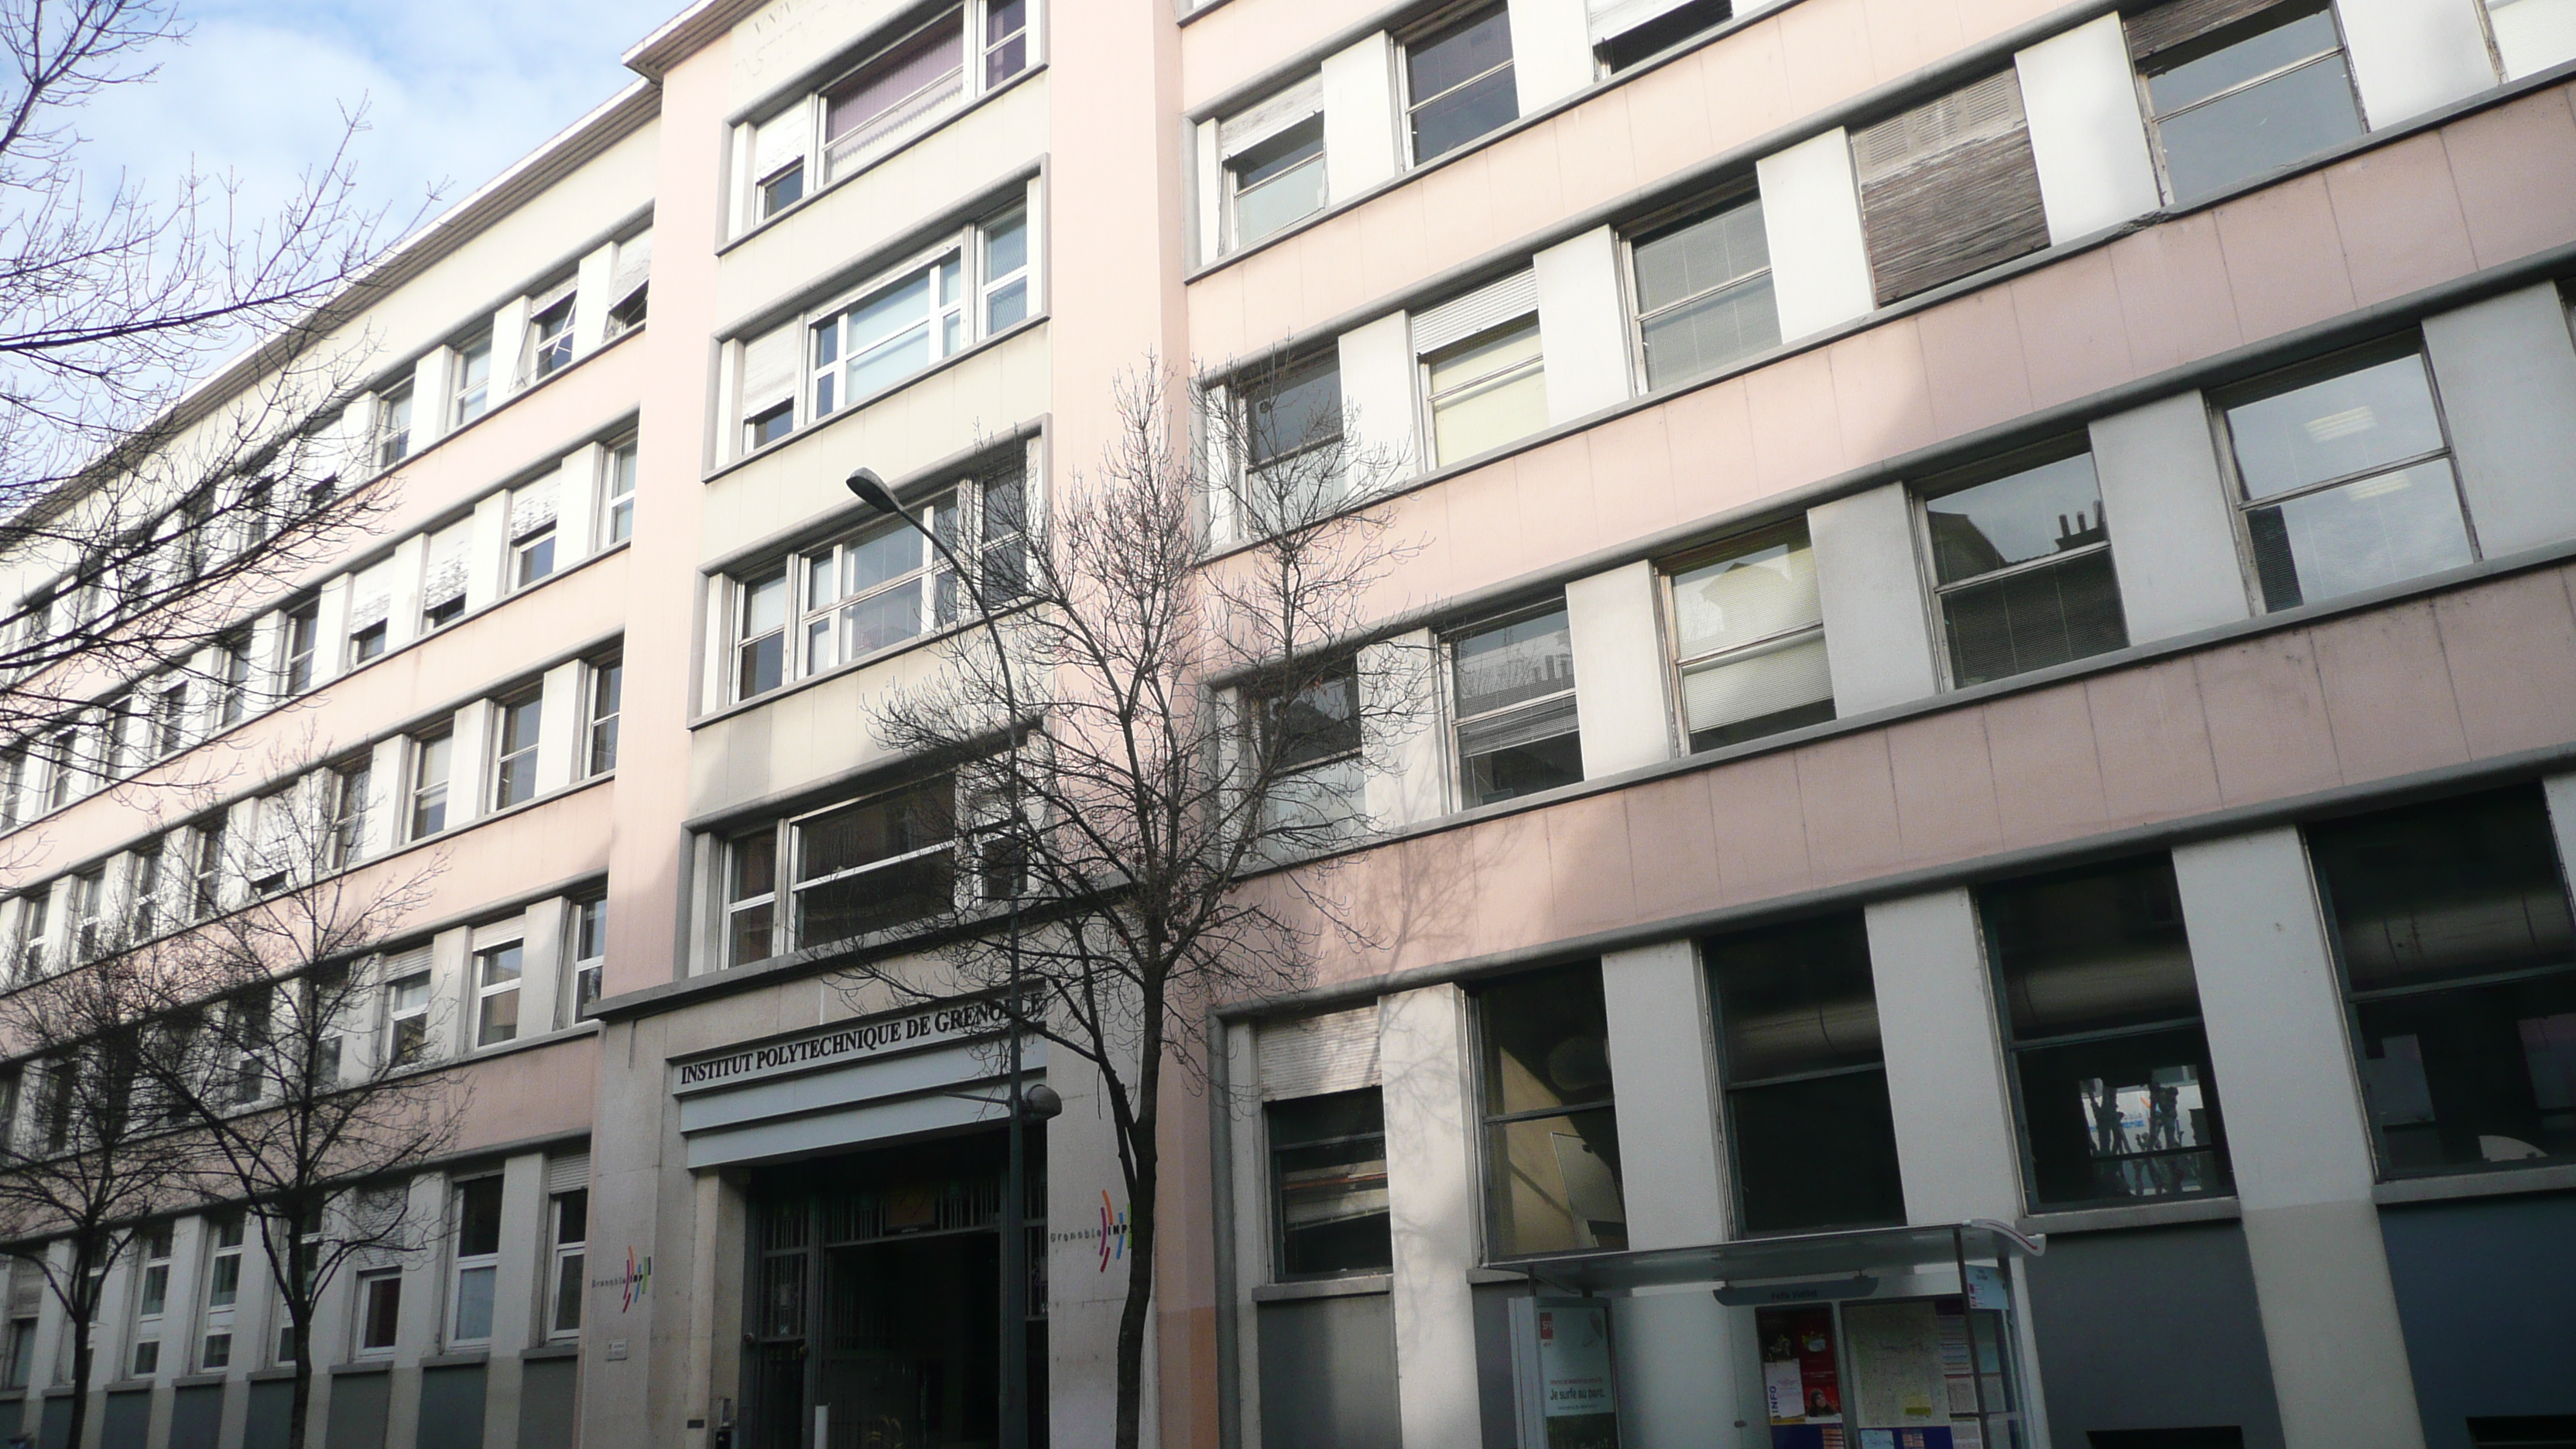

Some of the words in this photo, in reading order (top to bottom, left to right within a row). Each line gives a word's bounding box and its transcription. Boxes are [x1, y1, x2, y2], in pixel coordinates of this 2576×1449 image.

[681, 1053, 753, 1084] INSTITUT
[756, 1022, 902, 1070] POLYTECHNIQUE
[906, 1016, 931, 1040] DE
[934, 992, 1043, 1033] GRENOLE
[1108, 1225, 1128, 1236] INP
[1550, 1388, 1558, 1400] Je
[1559, 1387, 1577, 1400] surfe
[1578, 1389, 1587, 1399] au
[1769, 1386, 1779, 1413] INFO
